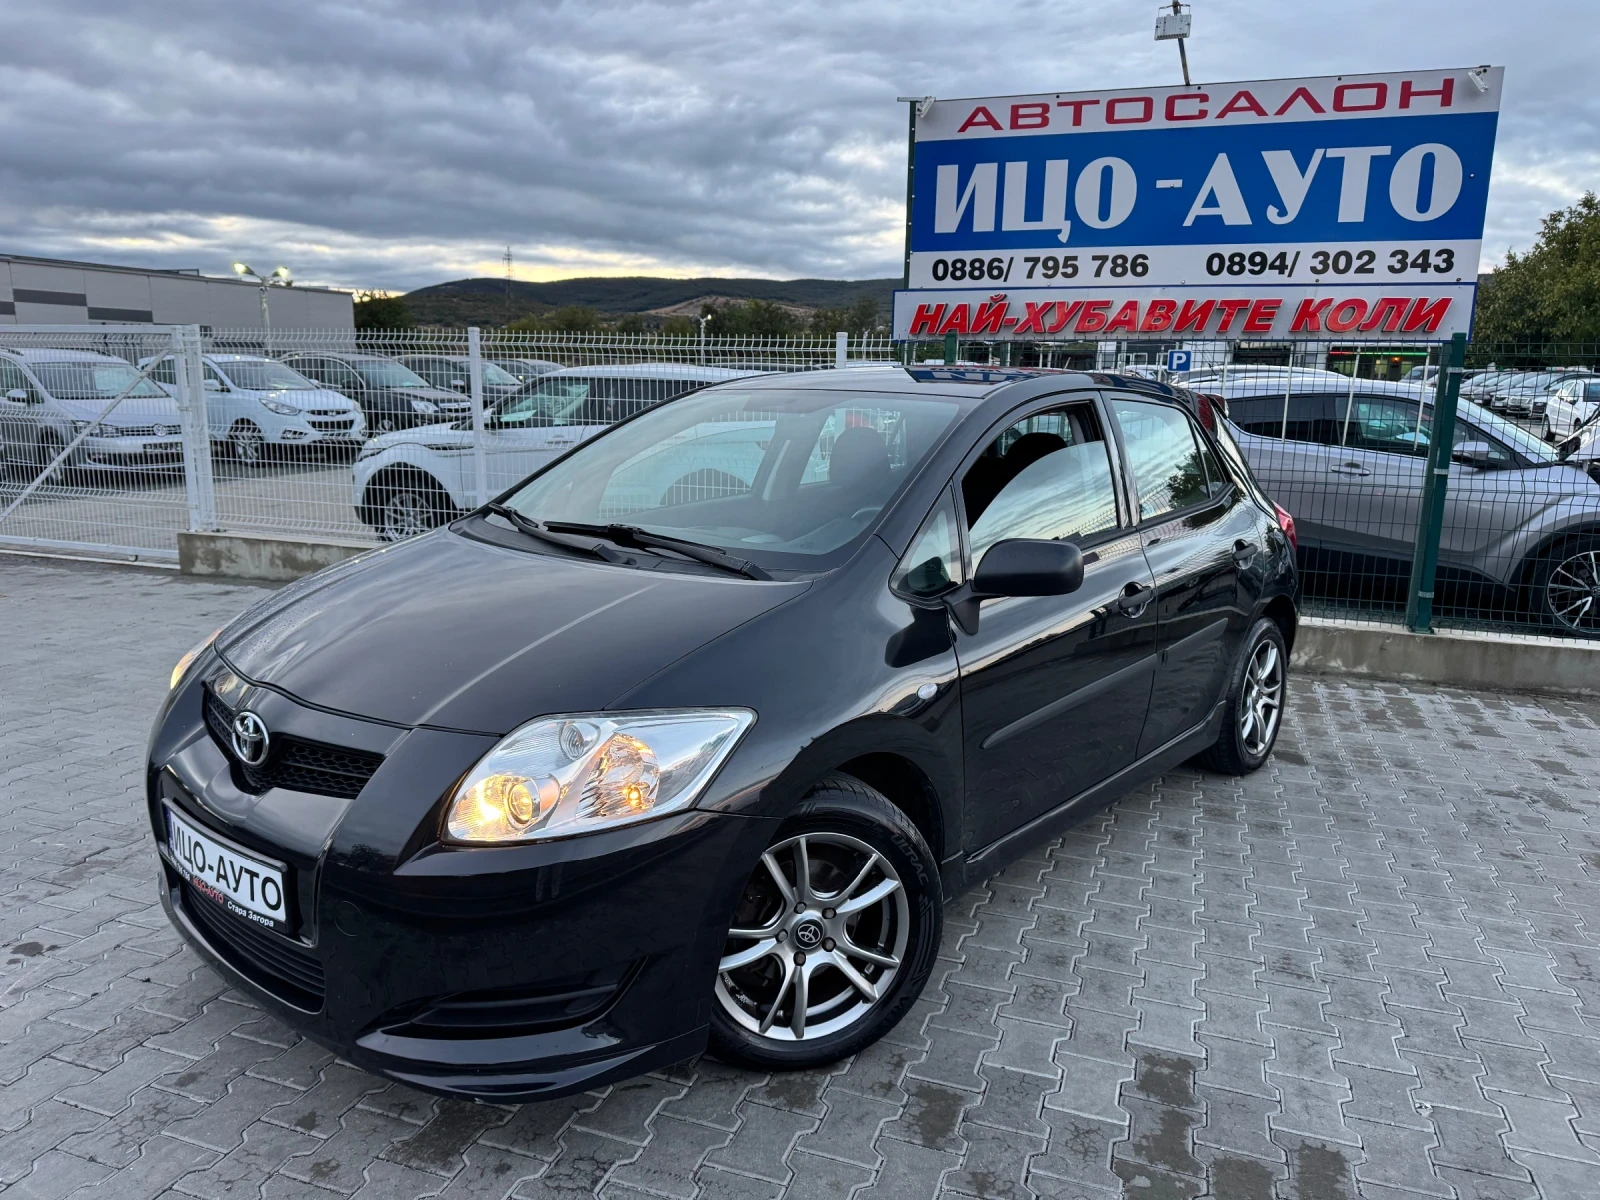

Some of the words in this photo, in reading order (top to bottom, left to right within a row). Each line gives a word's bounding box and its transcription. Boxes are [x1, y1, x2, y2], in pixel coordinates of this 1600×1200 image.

[957, 78, 1454, 133] АВТОСАЛОН
[932, 257, 1014, 282] 0886/
[1024, 255, 1079, 279] 795
[1091, 254, 1149, 278] 786
[1206, 250, 1301, 278] 0894/
[1310, 250, 1376, 275] 302
[1387, 249, 1455, 274] 343
[908, 293, 1283, 335] НАЙ-ХУБАВИТЕ
[1289, 297, 1453, 333] КОЛИ
[1172, 352, 1187, 370] P
[172, 821, 282, 911] ИЦО-АУТО
[227, 901, 247, 917] Стара
[248, 911, 274, 927] Загора
